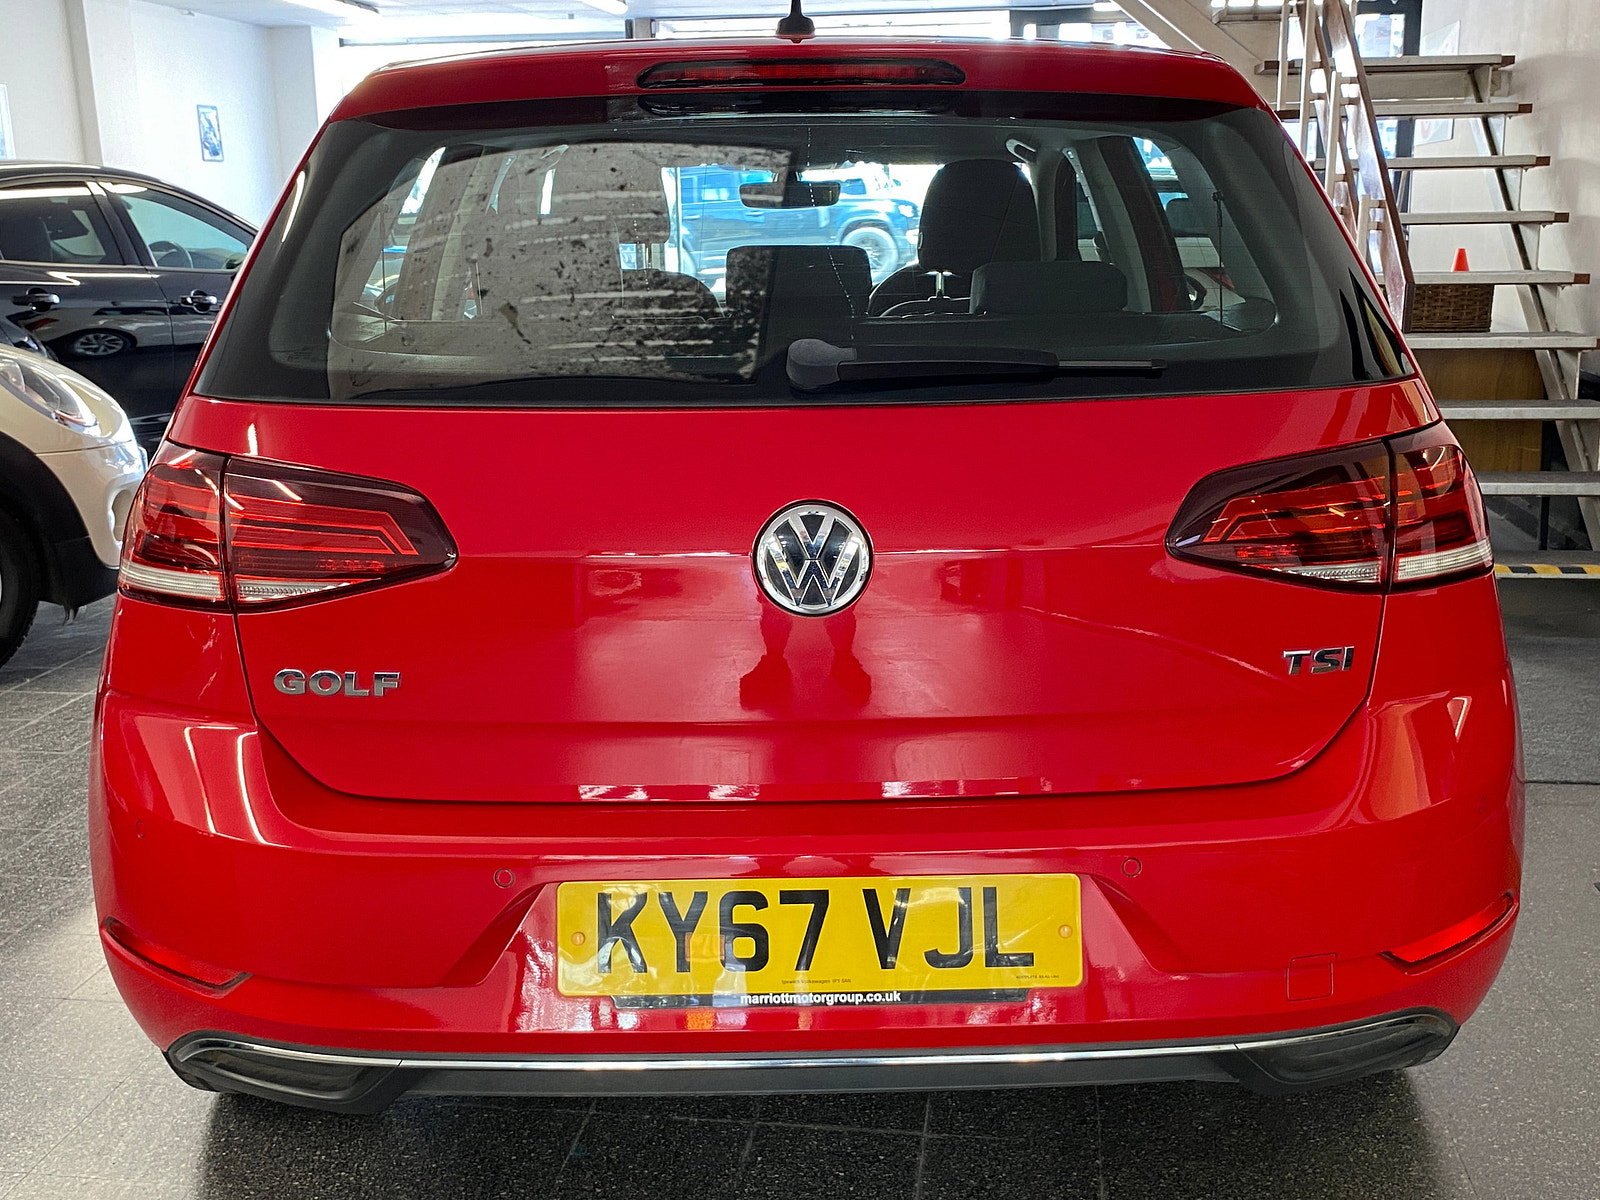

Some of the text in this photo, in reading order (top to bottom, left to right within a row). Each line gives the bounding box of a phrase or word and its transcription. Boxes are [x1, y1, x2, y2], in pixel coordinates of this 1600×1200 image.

[1283, 645, 1355, 675] TSI
[273, 668, 401, 697] GOLF
[598, 887, 1035, 973] KY67 VJL
[741, 990, 901, 1006] marriottmotorgroup.co.uk
